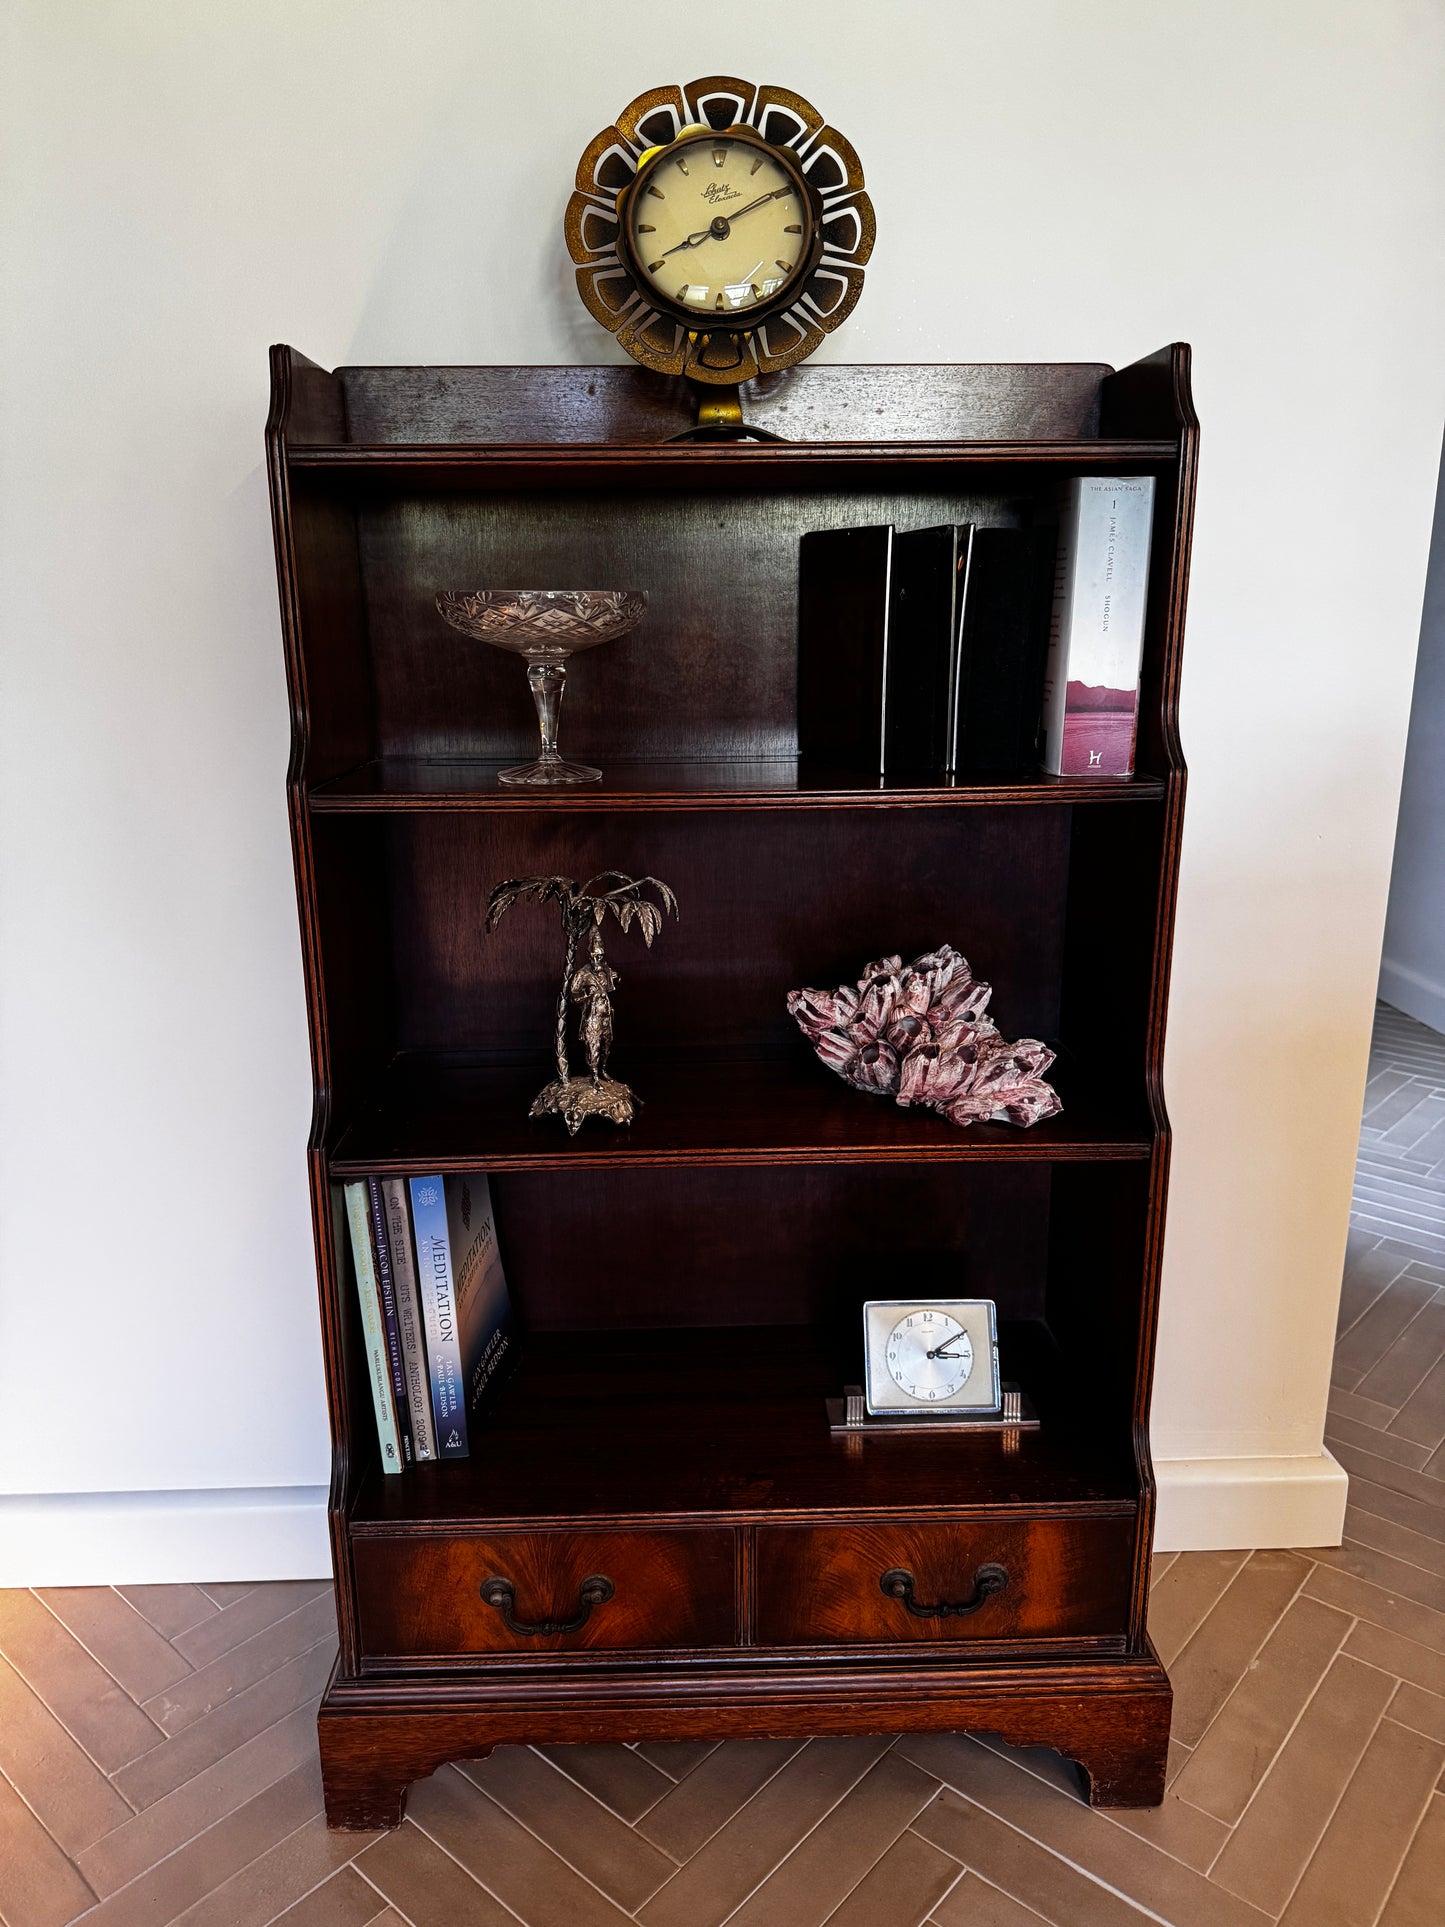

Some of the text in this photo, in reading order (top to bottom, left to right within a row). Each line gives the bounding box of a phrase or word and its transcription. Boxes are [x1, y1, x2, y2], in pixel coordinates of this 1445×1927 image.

[1105, 517, 1117, 582] JAMES CLAVELL
[1102, 595, 1111, 632] SHOGUN
[389, 1196, 407, 1265] ON THE SIDE
[377, 1244, 390, 1275] JACOB
[421, 1239, 429, 1253] AN
[382, 1280, 395, 1317] EPSTEIN
[400, 1284, 411, 1303] UTS
[430, 1235, 454, 1342] MEDITATION
[402, 1307, 417, 1354] WRITERS'
[906, 1318, 913, 1327] 11
[923, 1313, 933, 1322] 12
[945, 1317, 949, 1326] 1
[893, 1332, 902, 1342] 10
[389, 1332, 402, 1392] RICHARD CORK
[890, 1352, 896, 1360] 9
[408, 1362, 424, 1414] ANTHOLOGY
[437, 1365, 446, 1385] PAUL
[446, 1360, 457, 1411] IAN GAWLER
[439, 1386, 449, 1418] BEDSON
[909, 1385, 916, 1395] 7
[929, 1391, 936, 1399] 6
[415, 1419, 426, 1442] 2009
